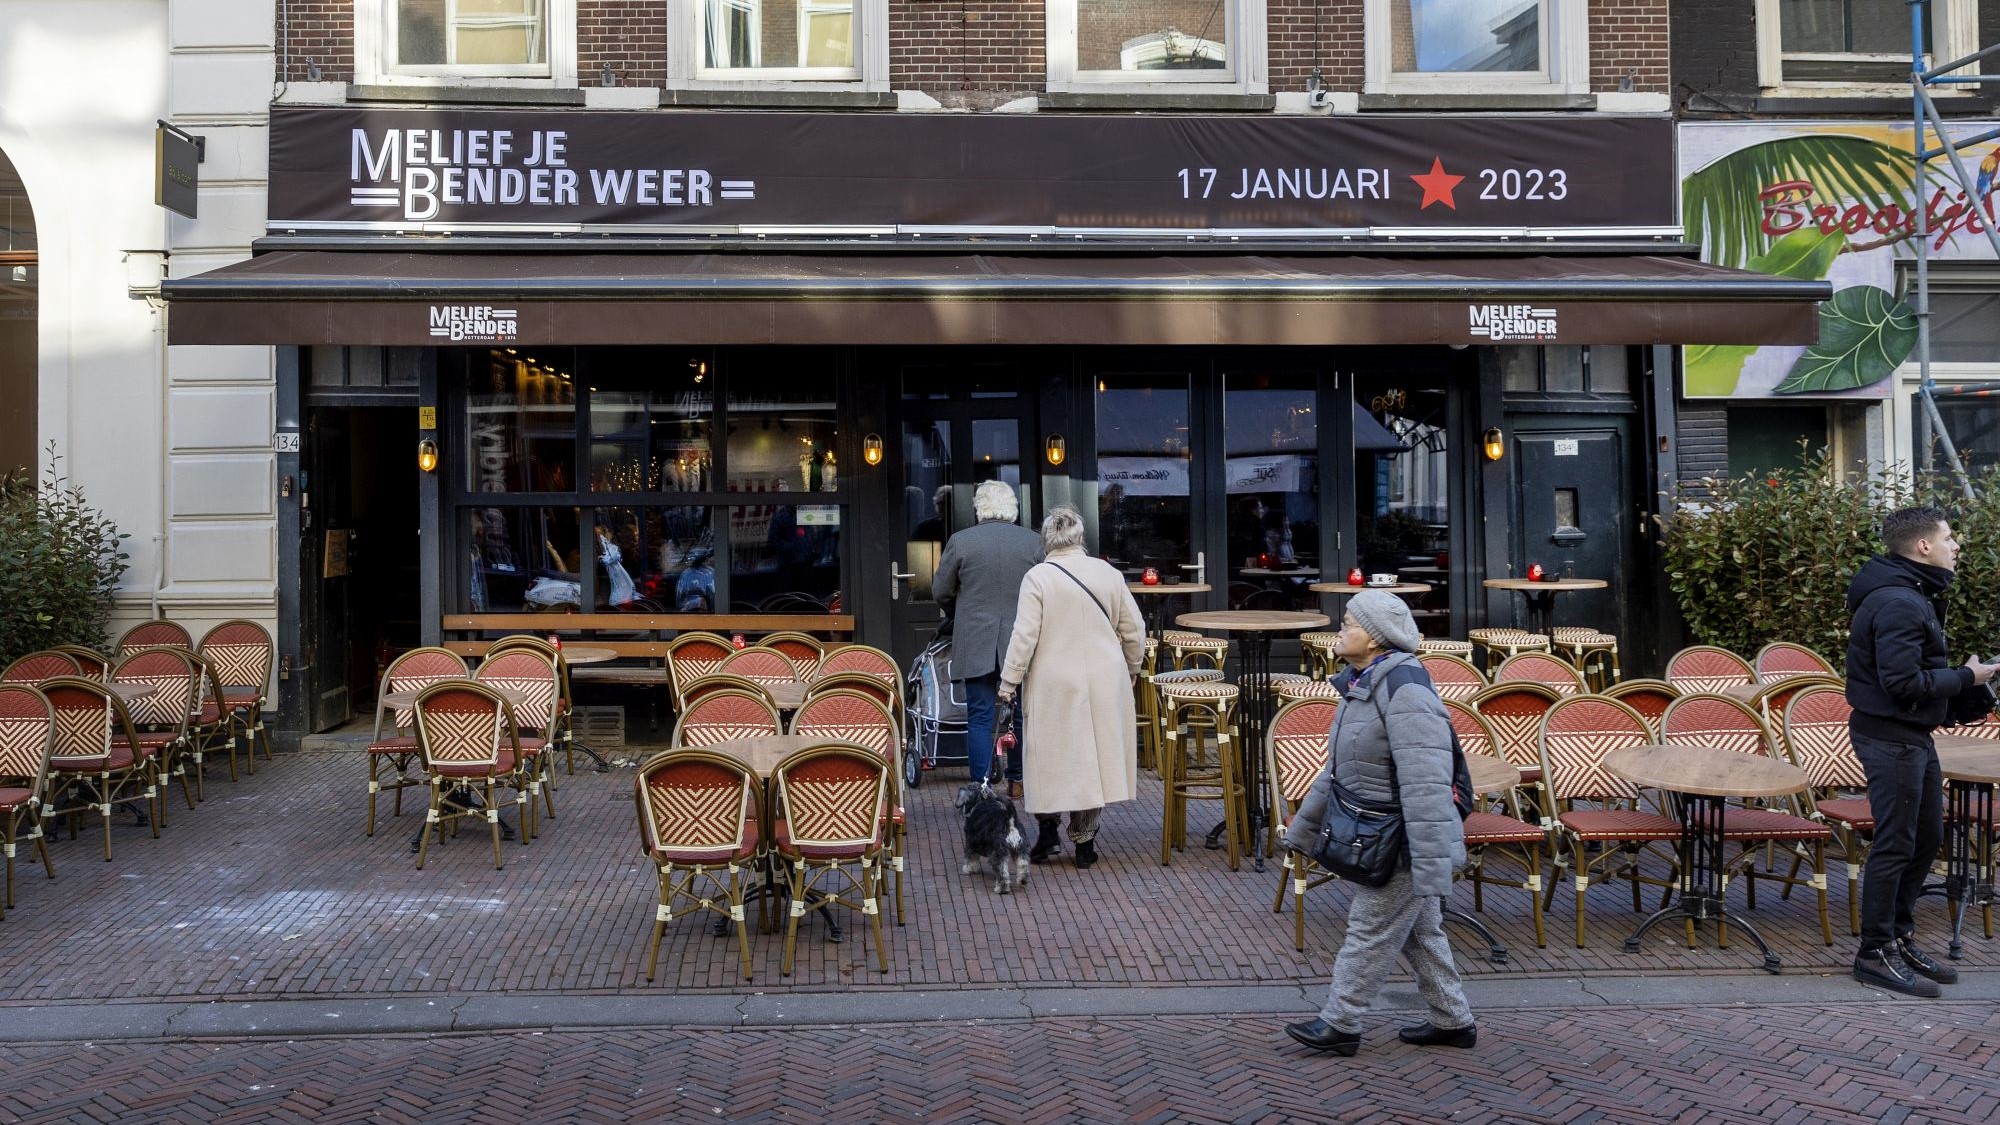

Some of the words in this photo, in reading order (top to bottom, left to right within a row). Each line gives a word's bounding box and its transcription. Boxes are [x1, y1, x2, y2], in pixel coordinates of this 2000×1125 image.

[351, 128, 513, 183] MELIEF
[523, 131, 567, 167] JE
[404, 167, 580, 221] BENDER
[589, 169, 713, 206] WEER
[1178, 168, 1217, 199] 17
[1230, 168, 1390, 200] JANUARI
[1479, 168, 1568, 201] 2023
[1758, 180, 2000, 251] Broodje
[430, 306, 493, 327] MELIEF
[1469, 305, 1532, 326] MELIEF
[450, 320, 517, 341] BENDER
[1490, 319, 1557, 341] BENDER
[276, 436, 299, 450] 134
